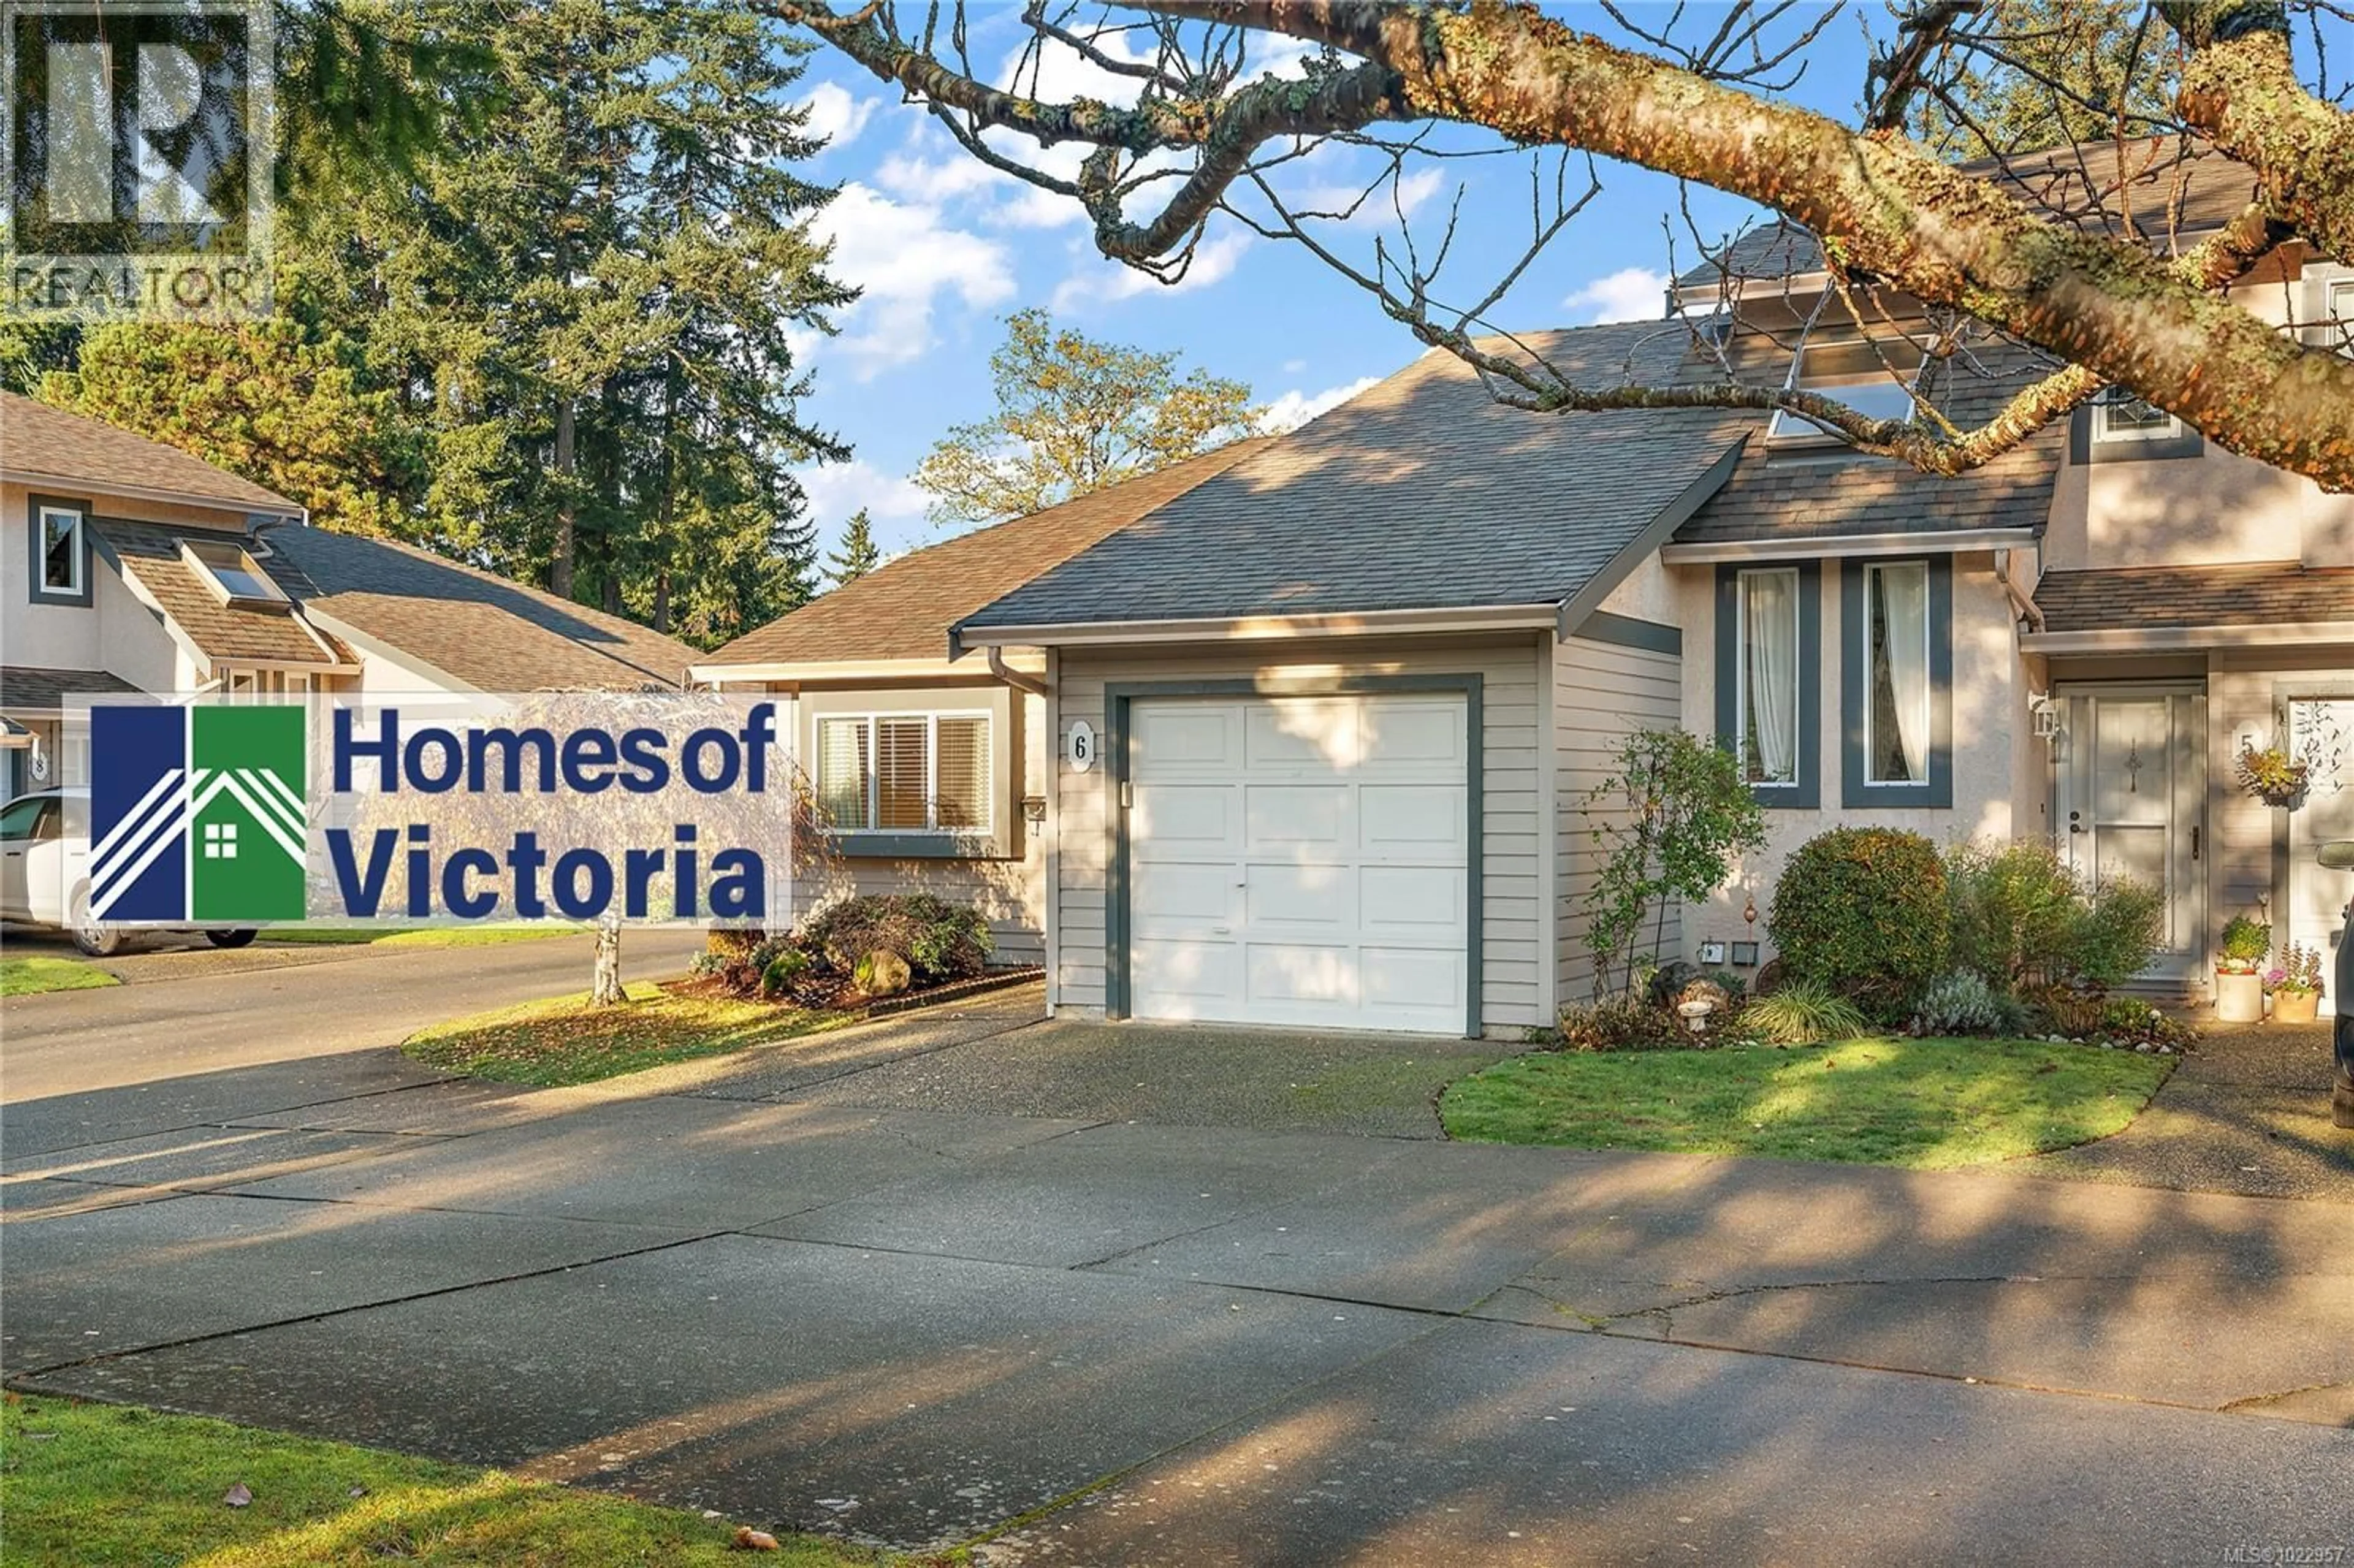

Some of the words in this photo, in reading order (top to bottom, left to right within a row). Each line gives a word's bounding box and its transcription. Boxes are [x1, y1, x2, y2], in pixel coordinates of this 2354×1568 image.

[1075, 736, 1086, 759] 6
[2241, 734, 2254, 756] 5
[36, 759, 44, 772] 8
